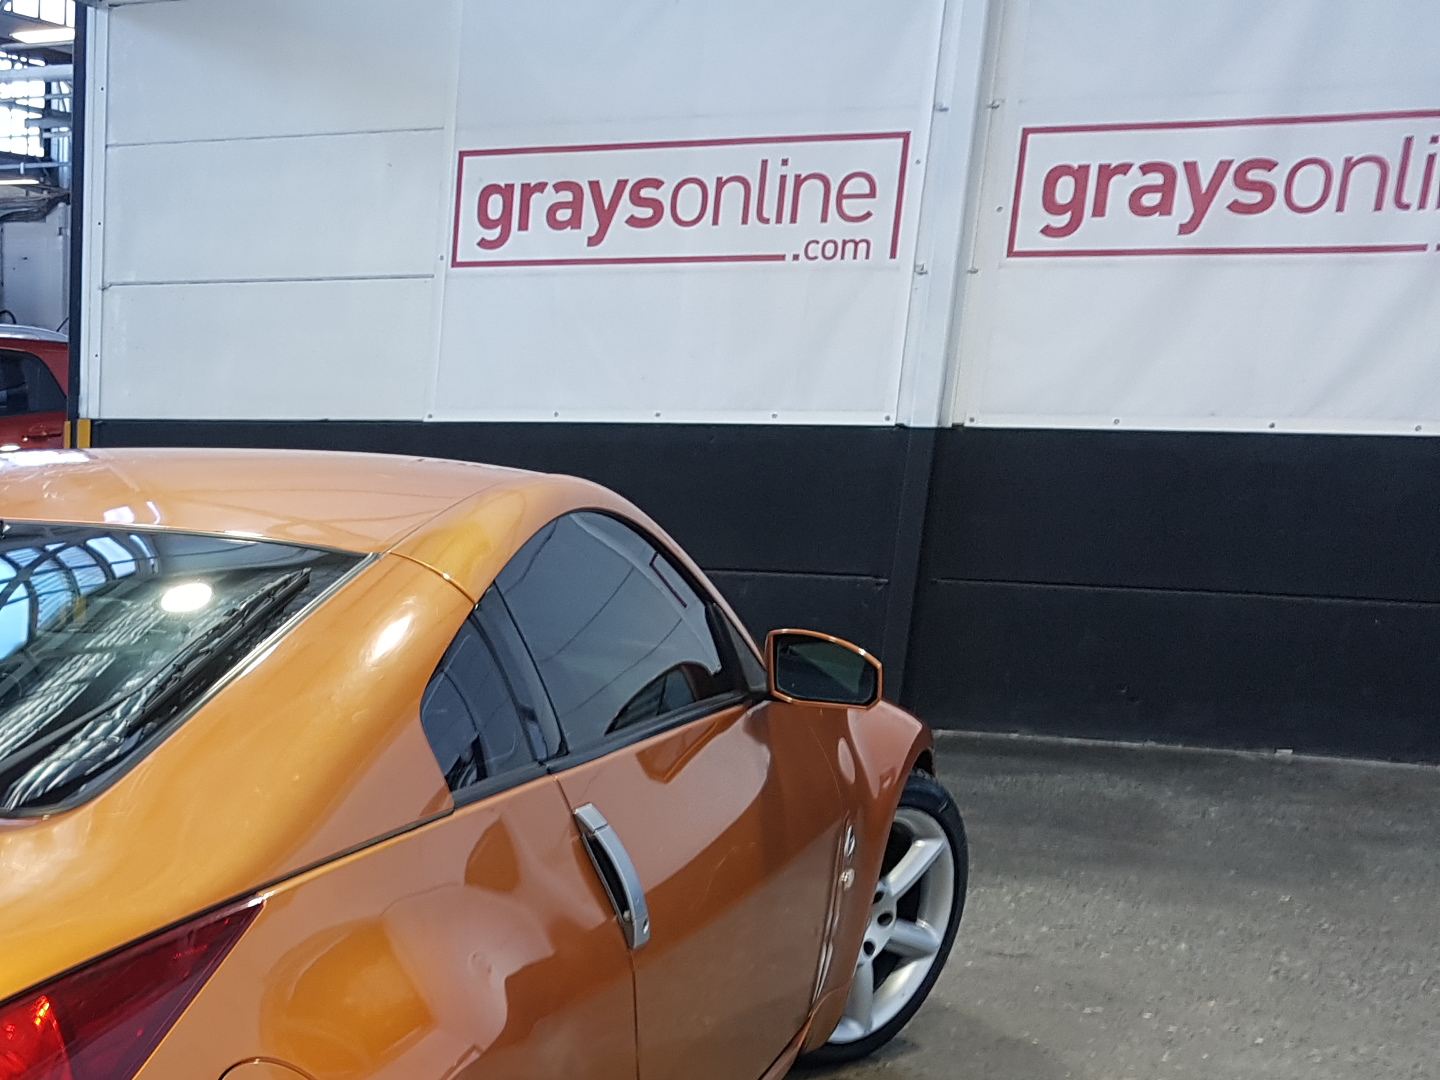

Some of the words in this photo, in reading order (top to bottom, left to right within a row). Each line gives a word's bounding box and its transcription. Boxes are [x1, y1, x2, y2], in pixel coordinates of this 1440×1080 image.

[475, 157, 878, 250] graysonline
[1039, 134, 1440, 239] graysonli
[791, 236, 871, 262] .com
